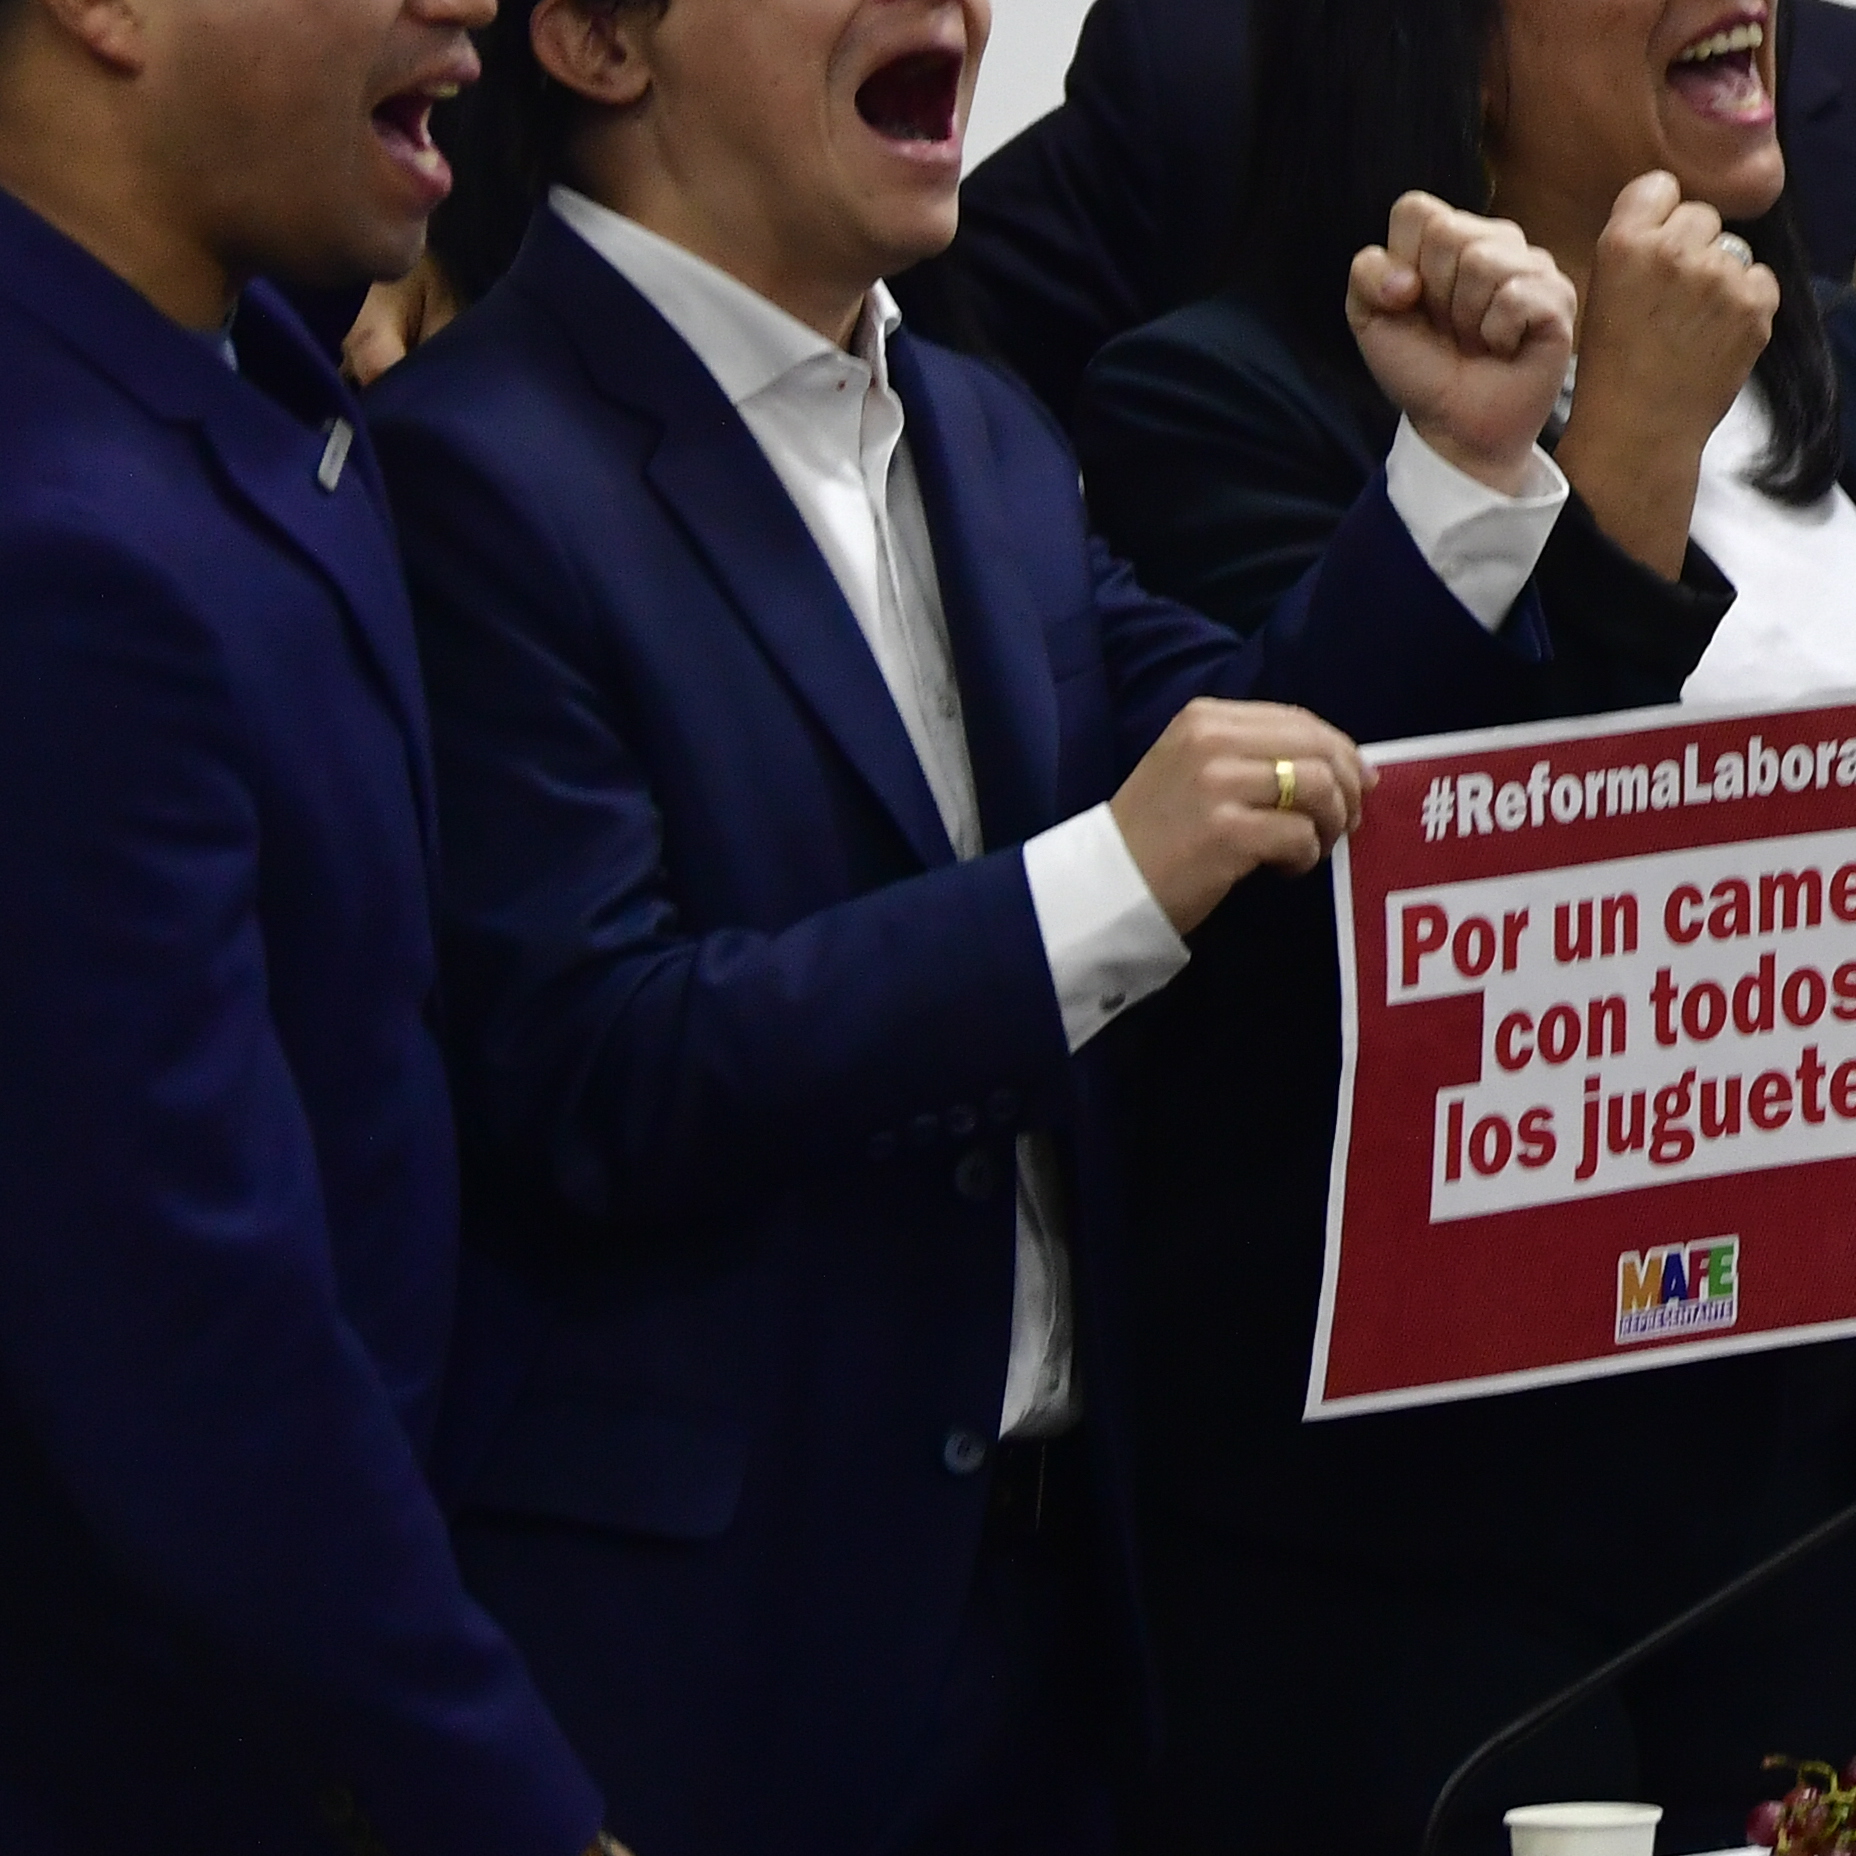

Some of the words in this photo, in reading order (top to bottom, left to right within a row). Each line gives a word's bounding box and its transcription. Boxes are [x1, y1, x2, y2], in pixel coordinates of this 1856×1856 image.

[1401, 902, 1528, 988] Por
[1553, 891, 1639, 964] un
[1494, 991, 1627, 1074] con
[1443, 1101, 1557, 1183] los
[1621, 1244, 1735, 1312] MAFE
